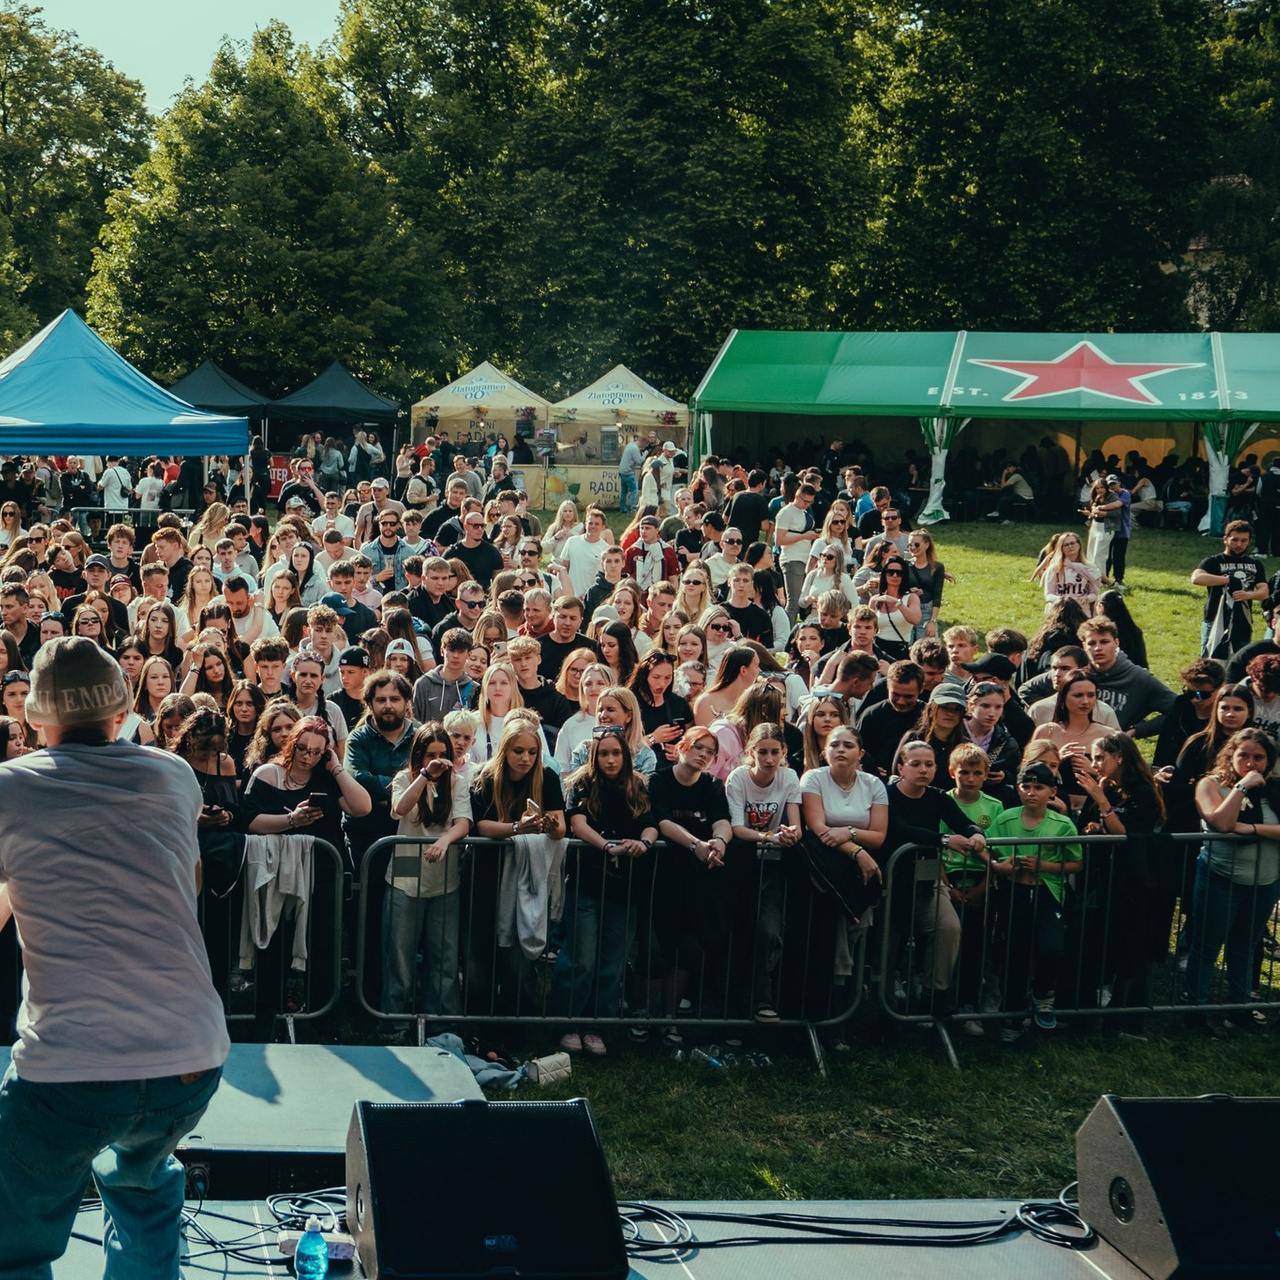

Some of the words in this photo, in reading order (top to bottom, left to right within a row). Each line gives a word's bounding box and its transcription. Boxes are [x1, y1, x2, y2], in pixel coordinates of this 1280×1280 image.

[450, 383, 507, 393] Zlatopramen
[927, 386, 989, 397] EST.
[587, 391, 644, 400] Zlatopramen
